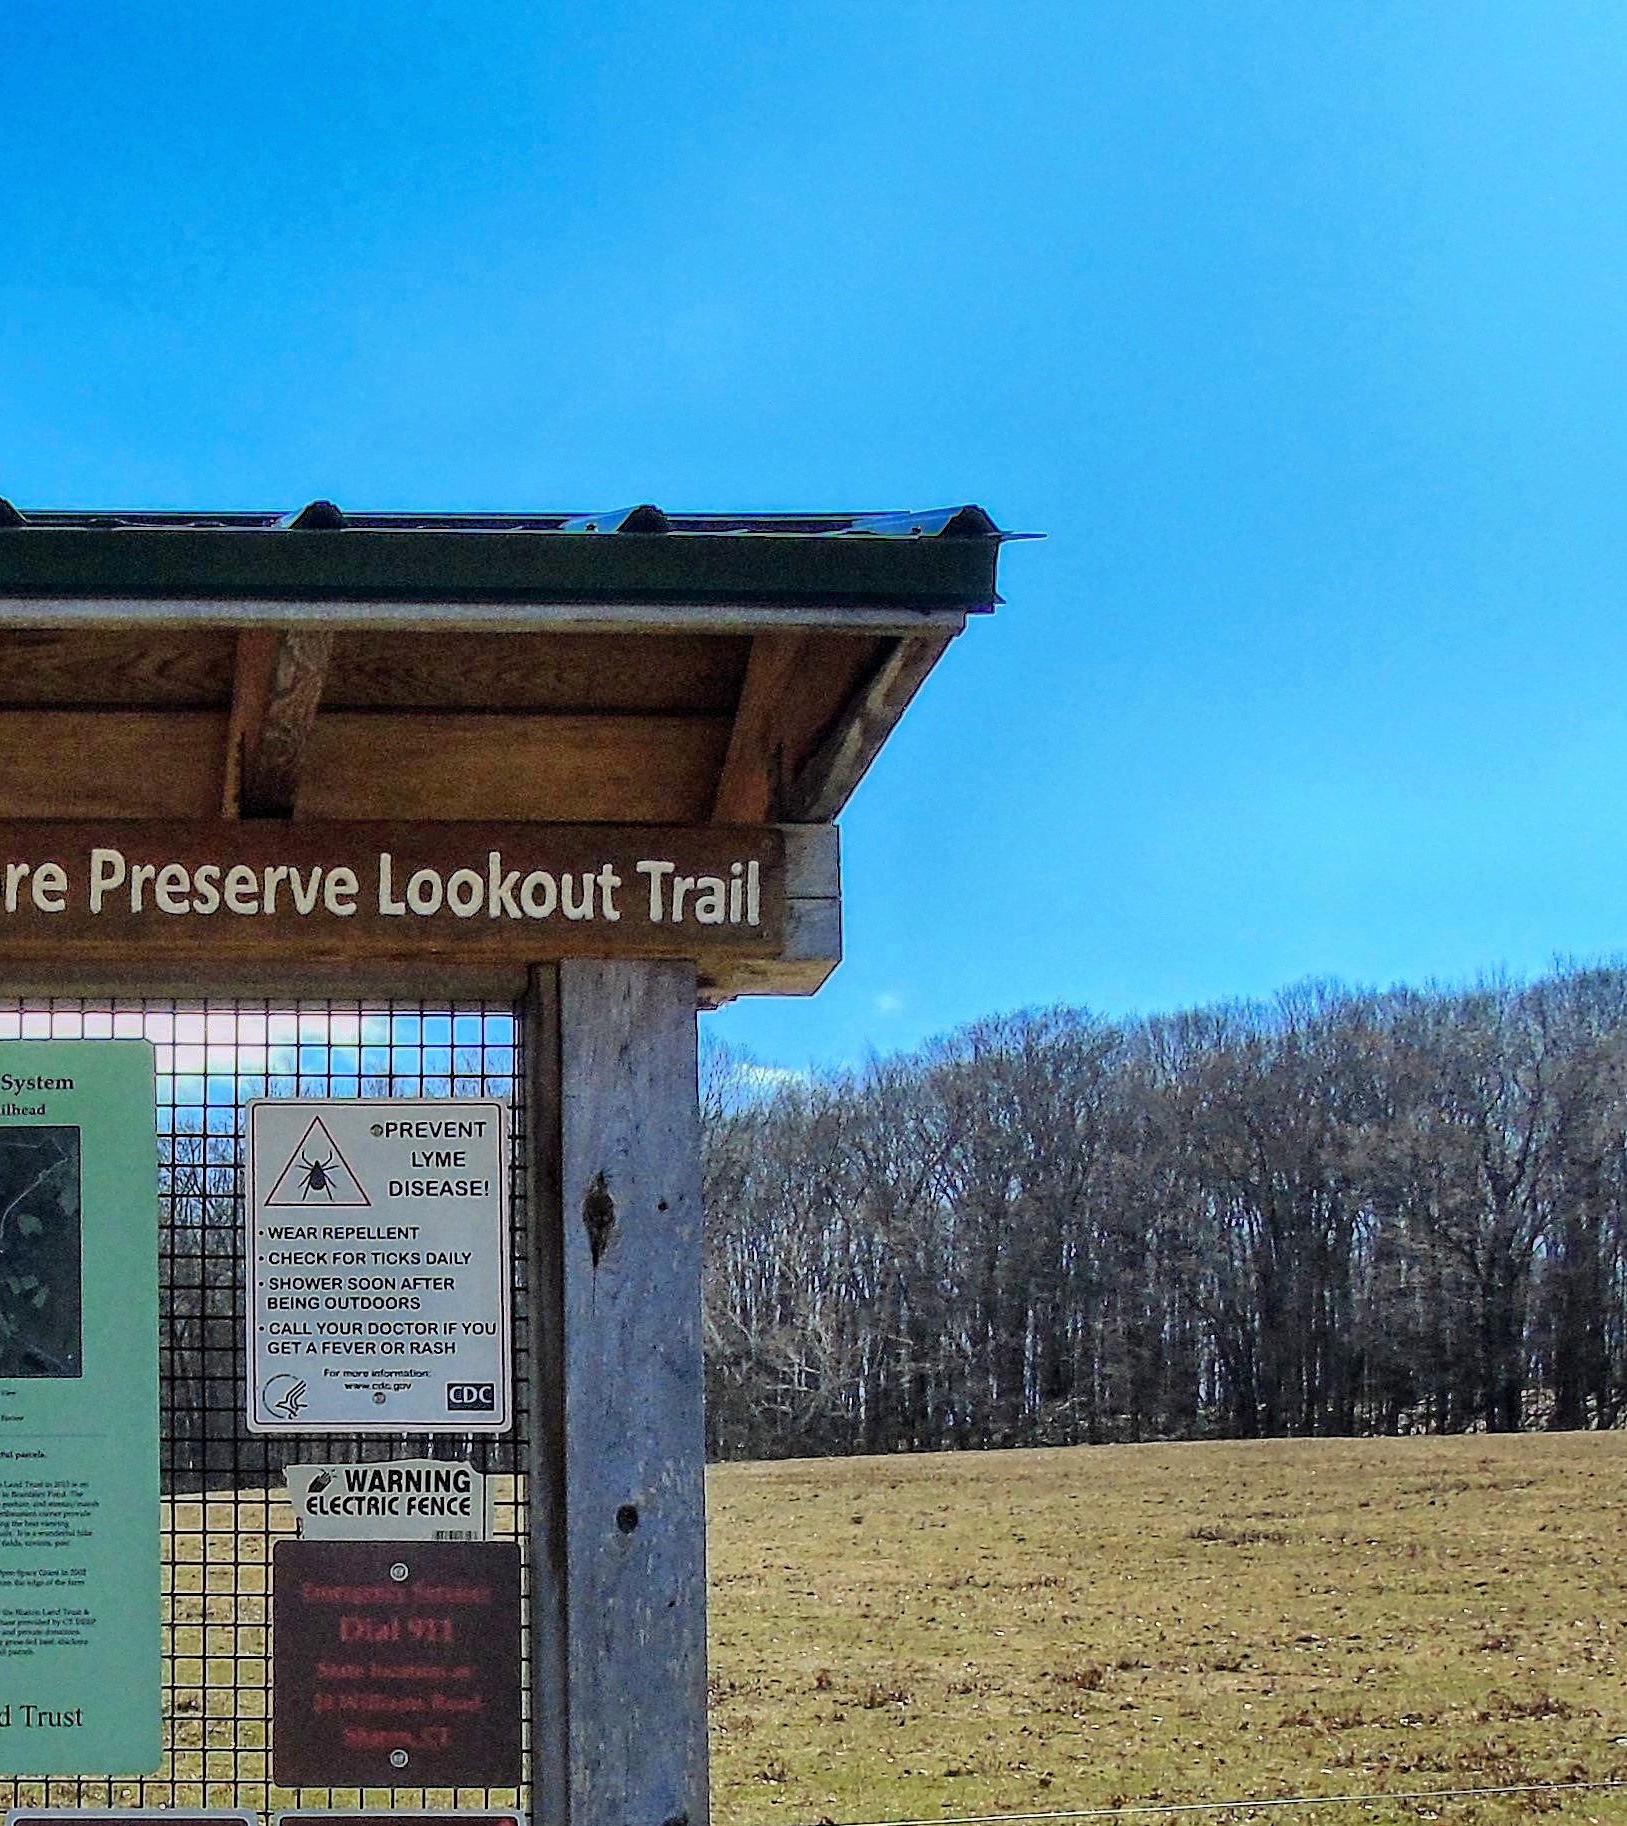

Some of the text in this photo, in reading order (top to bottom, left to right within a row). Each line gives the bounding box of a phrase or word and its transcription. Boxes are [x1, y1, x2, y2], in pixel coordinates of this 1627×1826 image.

[89, 848, 358, 917] Preserve
[379, 851, 622, 919] Lookout
[636, 859, 760, 927] Trail
[1, 1074, 74, 1096] System
[385, 1121, 487, 1139] PREVENT
[411, 1152, 466, 1168] LYME
[389, 1180, 490, 1197] DISEASE!
[268, 1227, 420, 1240] WEAR REPELLENT
[268, 1252, 473, 1266] CHECK FOR TICKS DAILY
[268, 1277, 455, 1291] SHOWER SOON AFTER
[267, 1296, 421, 1311] BEING OUTDOORS
[269, 1322, 497, 1336] CALL YOUR DOCTOR IF YOU
[267, 1341, 456, 1356] GET A FEVER OR RASH
[323, 1368, 340, 1378] For
[343, 1368, 369, 1378] more
[449, 1386, 492, 1404] CDC
[345, 1469, 471, 1494] WARNING
[306, 1495, 471, 1516] ELECTRIC FENCE
[339, 1614, 400, 1640] Dial
[19, 1704, 84, 1728] Trust
